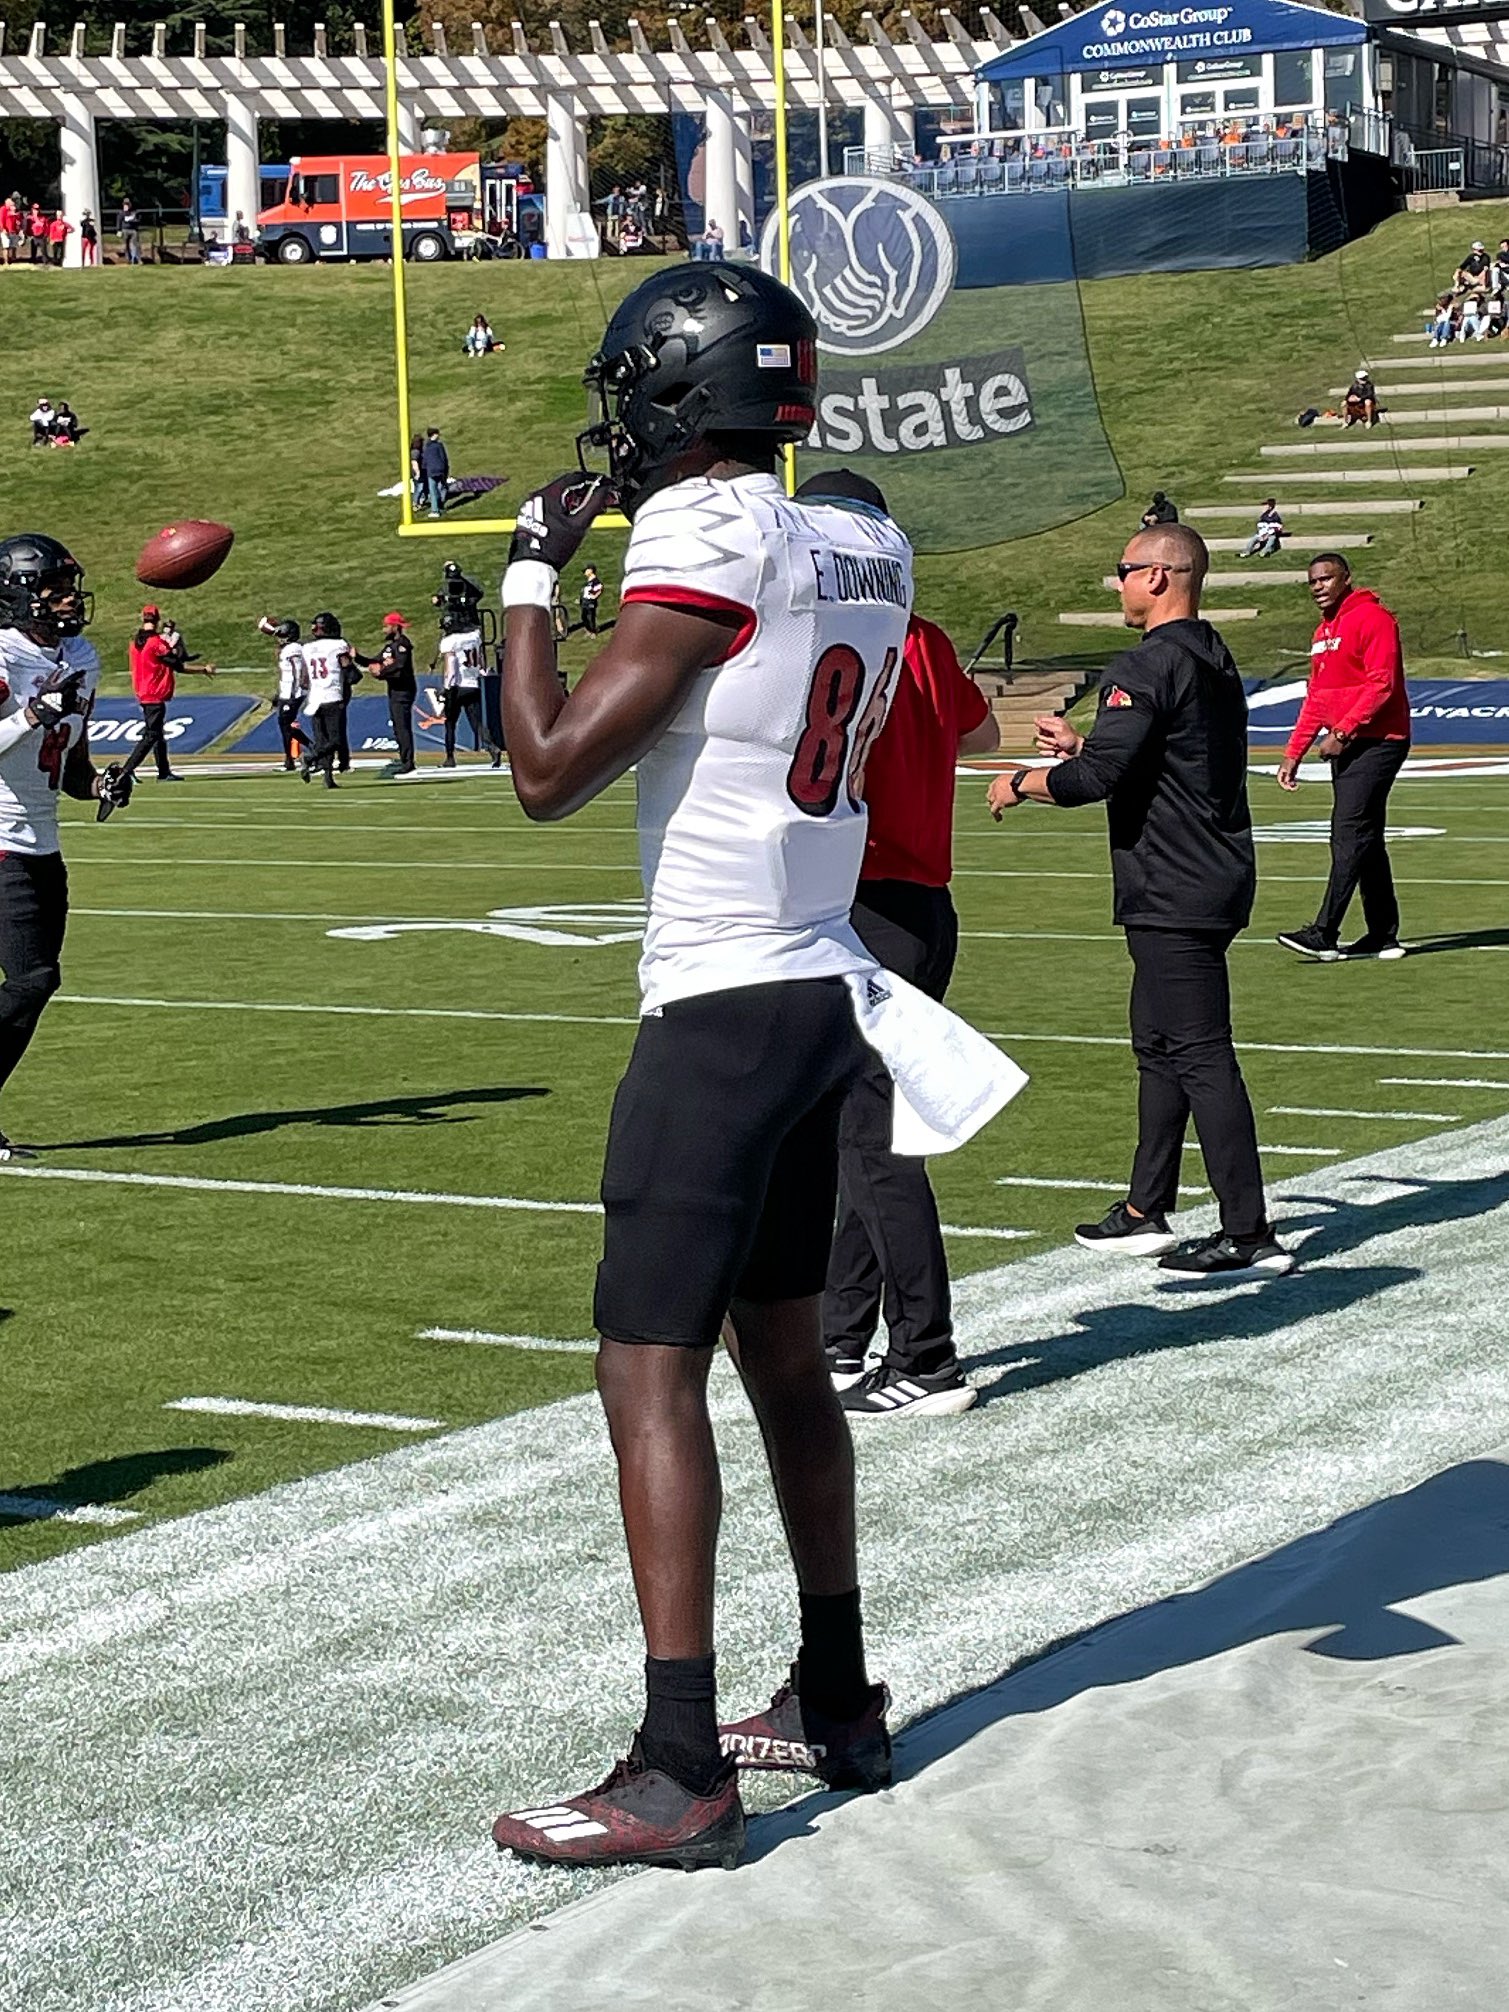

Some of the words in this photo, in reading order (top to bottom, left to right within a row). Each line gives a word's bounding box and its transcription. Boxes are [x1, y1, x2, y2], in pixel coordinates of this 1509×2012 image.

[1129, 10, 1179, 30] CoStar
[1082, 31, 1211, 60] COMMONWEALTH
[1213, 27, 1252, 46] CLUB
[350, 169, 376, 192] The
[376, 170, 411, 193] Gs
[411, 167, 446, 188] Bus
[806, 367, 1032, 452] state
